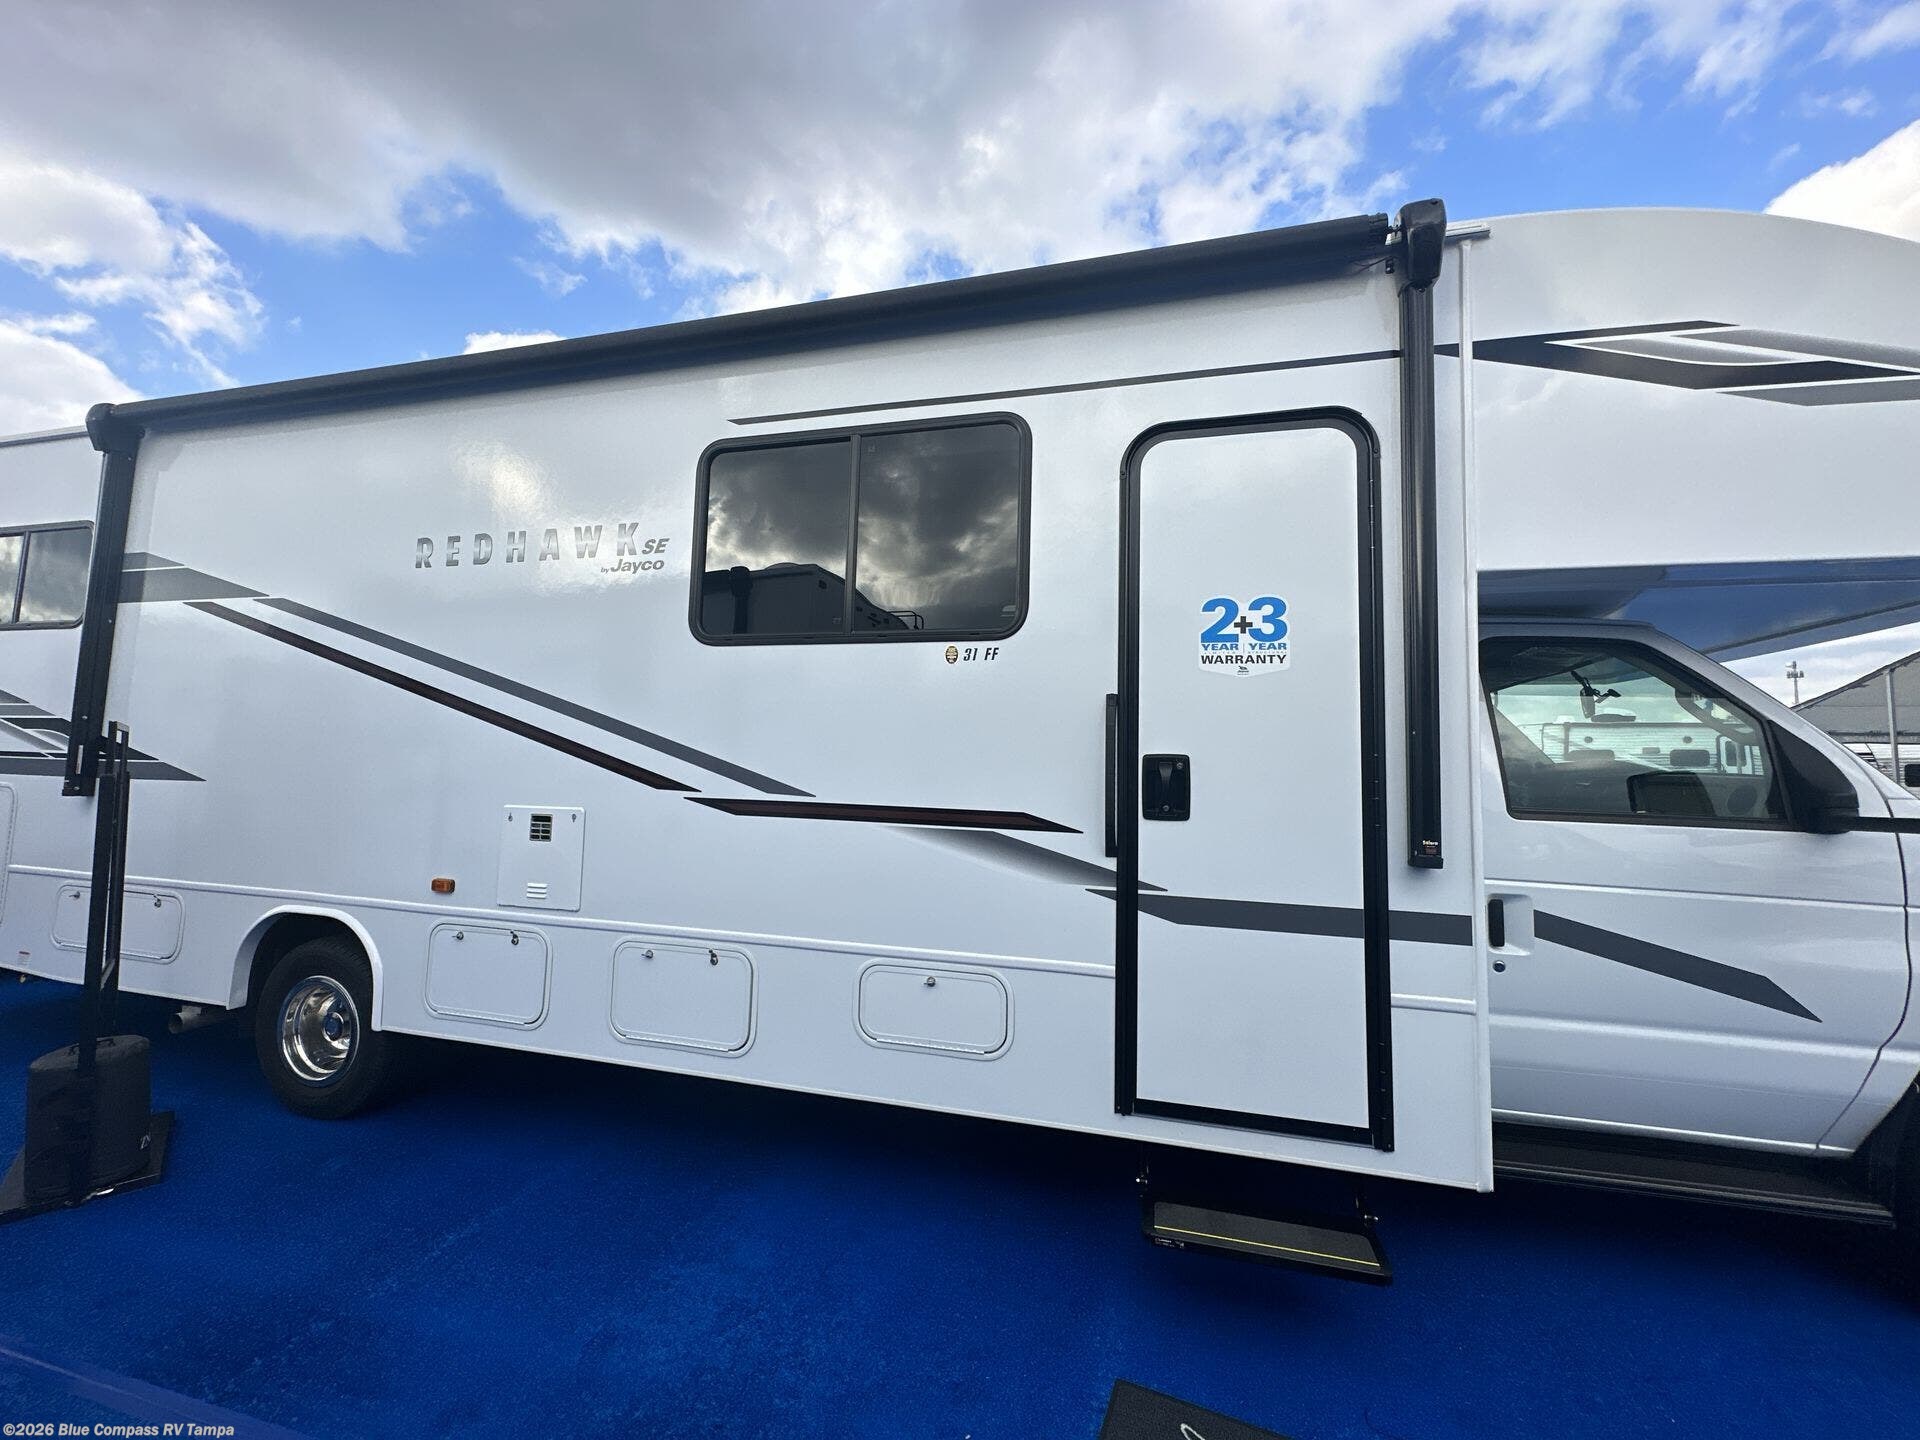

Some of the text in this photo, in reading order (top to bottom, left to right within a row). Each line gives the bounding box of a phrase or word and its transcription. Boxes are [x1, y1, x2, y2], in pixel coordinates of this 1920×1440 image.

[415, 522, 670, 569] REDHAWK SE
[610, 558, 665, 574] Jayco
[1201, 642, 1287, 651] YEAR YEAR
[963, 647, 978, 661] 31
[984, 647, 999, 661] FF
[1200, 654, 1287, 664] WARRANTY
